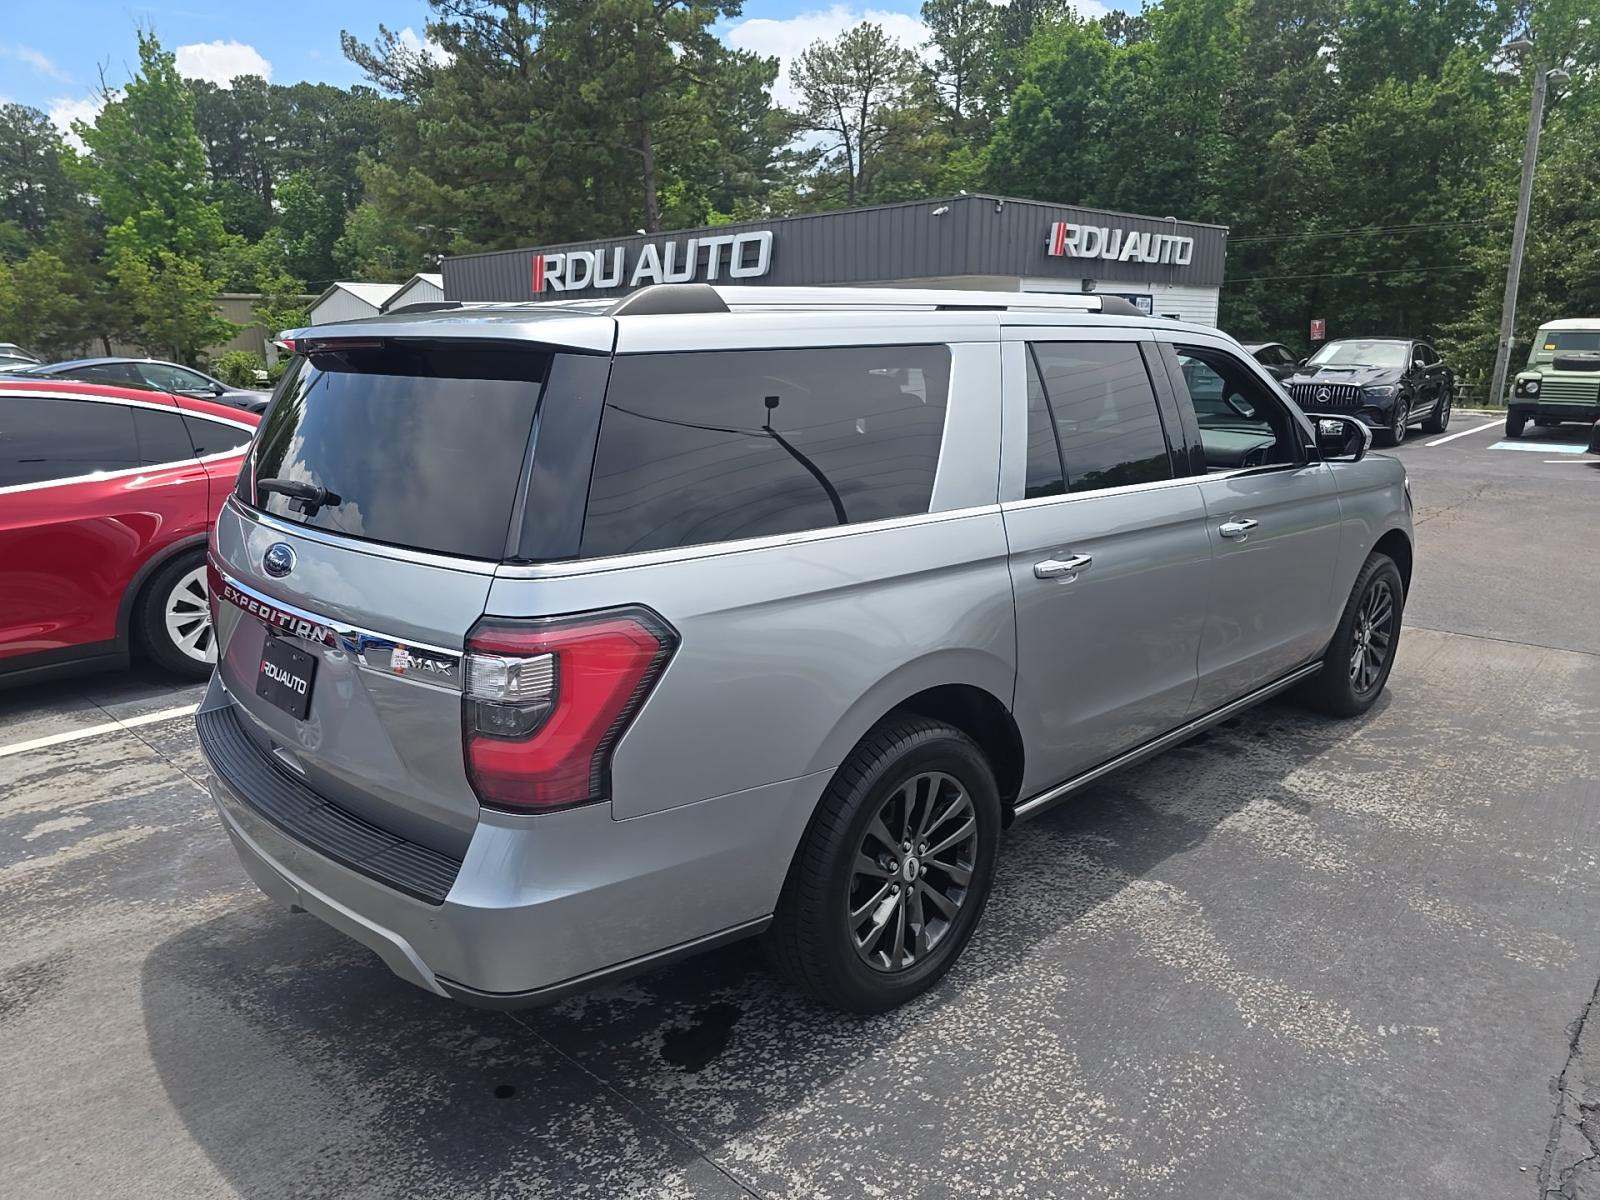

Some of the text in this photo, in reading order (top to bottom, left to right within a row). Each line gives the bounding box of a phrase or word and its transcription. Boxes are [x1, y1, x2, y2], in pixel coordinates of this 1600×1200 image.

[532, 230, 773, 293] RDU AUTO
[224, 586, 330, 641] EXPEDITION
[407, 654, 453, 677] MAX
